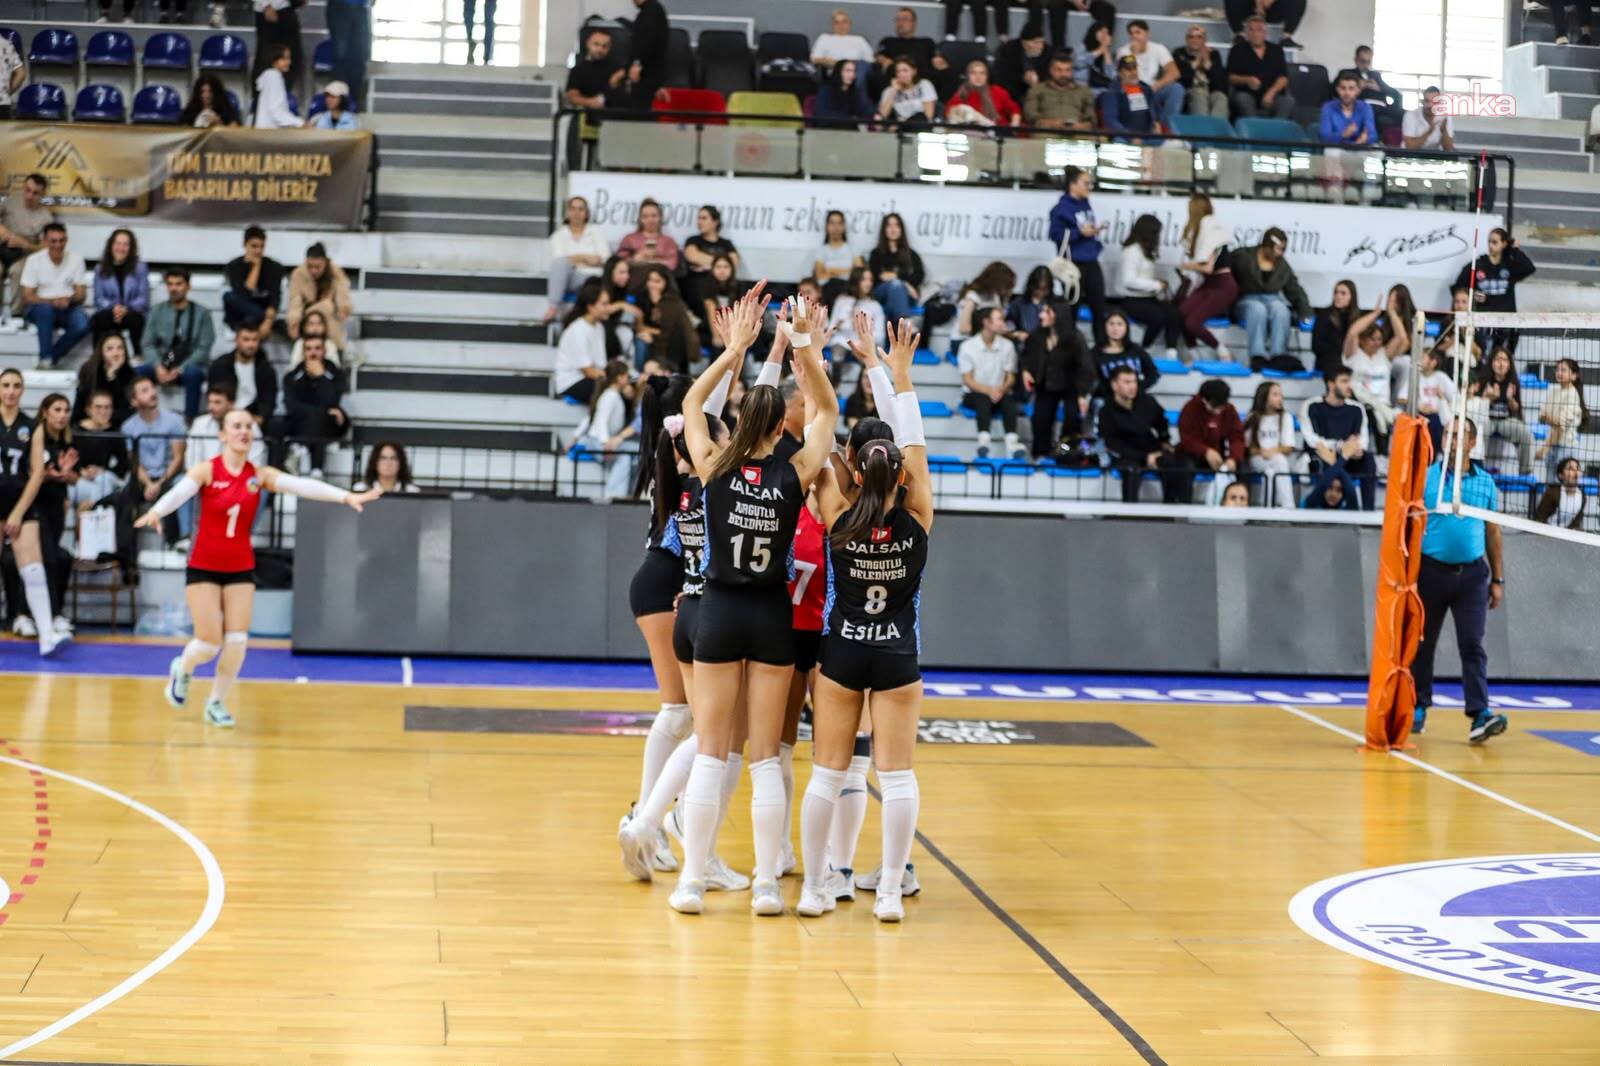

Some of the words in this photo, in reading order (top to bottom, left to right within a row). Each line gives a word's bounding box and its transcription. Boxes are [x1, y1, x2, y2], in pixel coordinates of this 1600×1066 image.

[206, 153, 332, 176] TAKIMLARIMIZA
[164, 179, 253, 204] BAŞARILAR
[256, 177, 318, 203] DİLERİZ
[981, 214, 1051, 241] zama
[225, 503, 241, 538] 1
[729, 532, 772, 573] 15
[845, 537, 914, 554] DALSAN
[849, 565, 907, 581] BELEDİYESİ
[853, 557, 903, 571] TURGUTLU
[864, 584, 888, 615] 8
